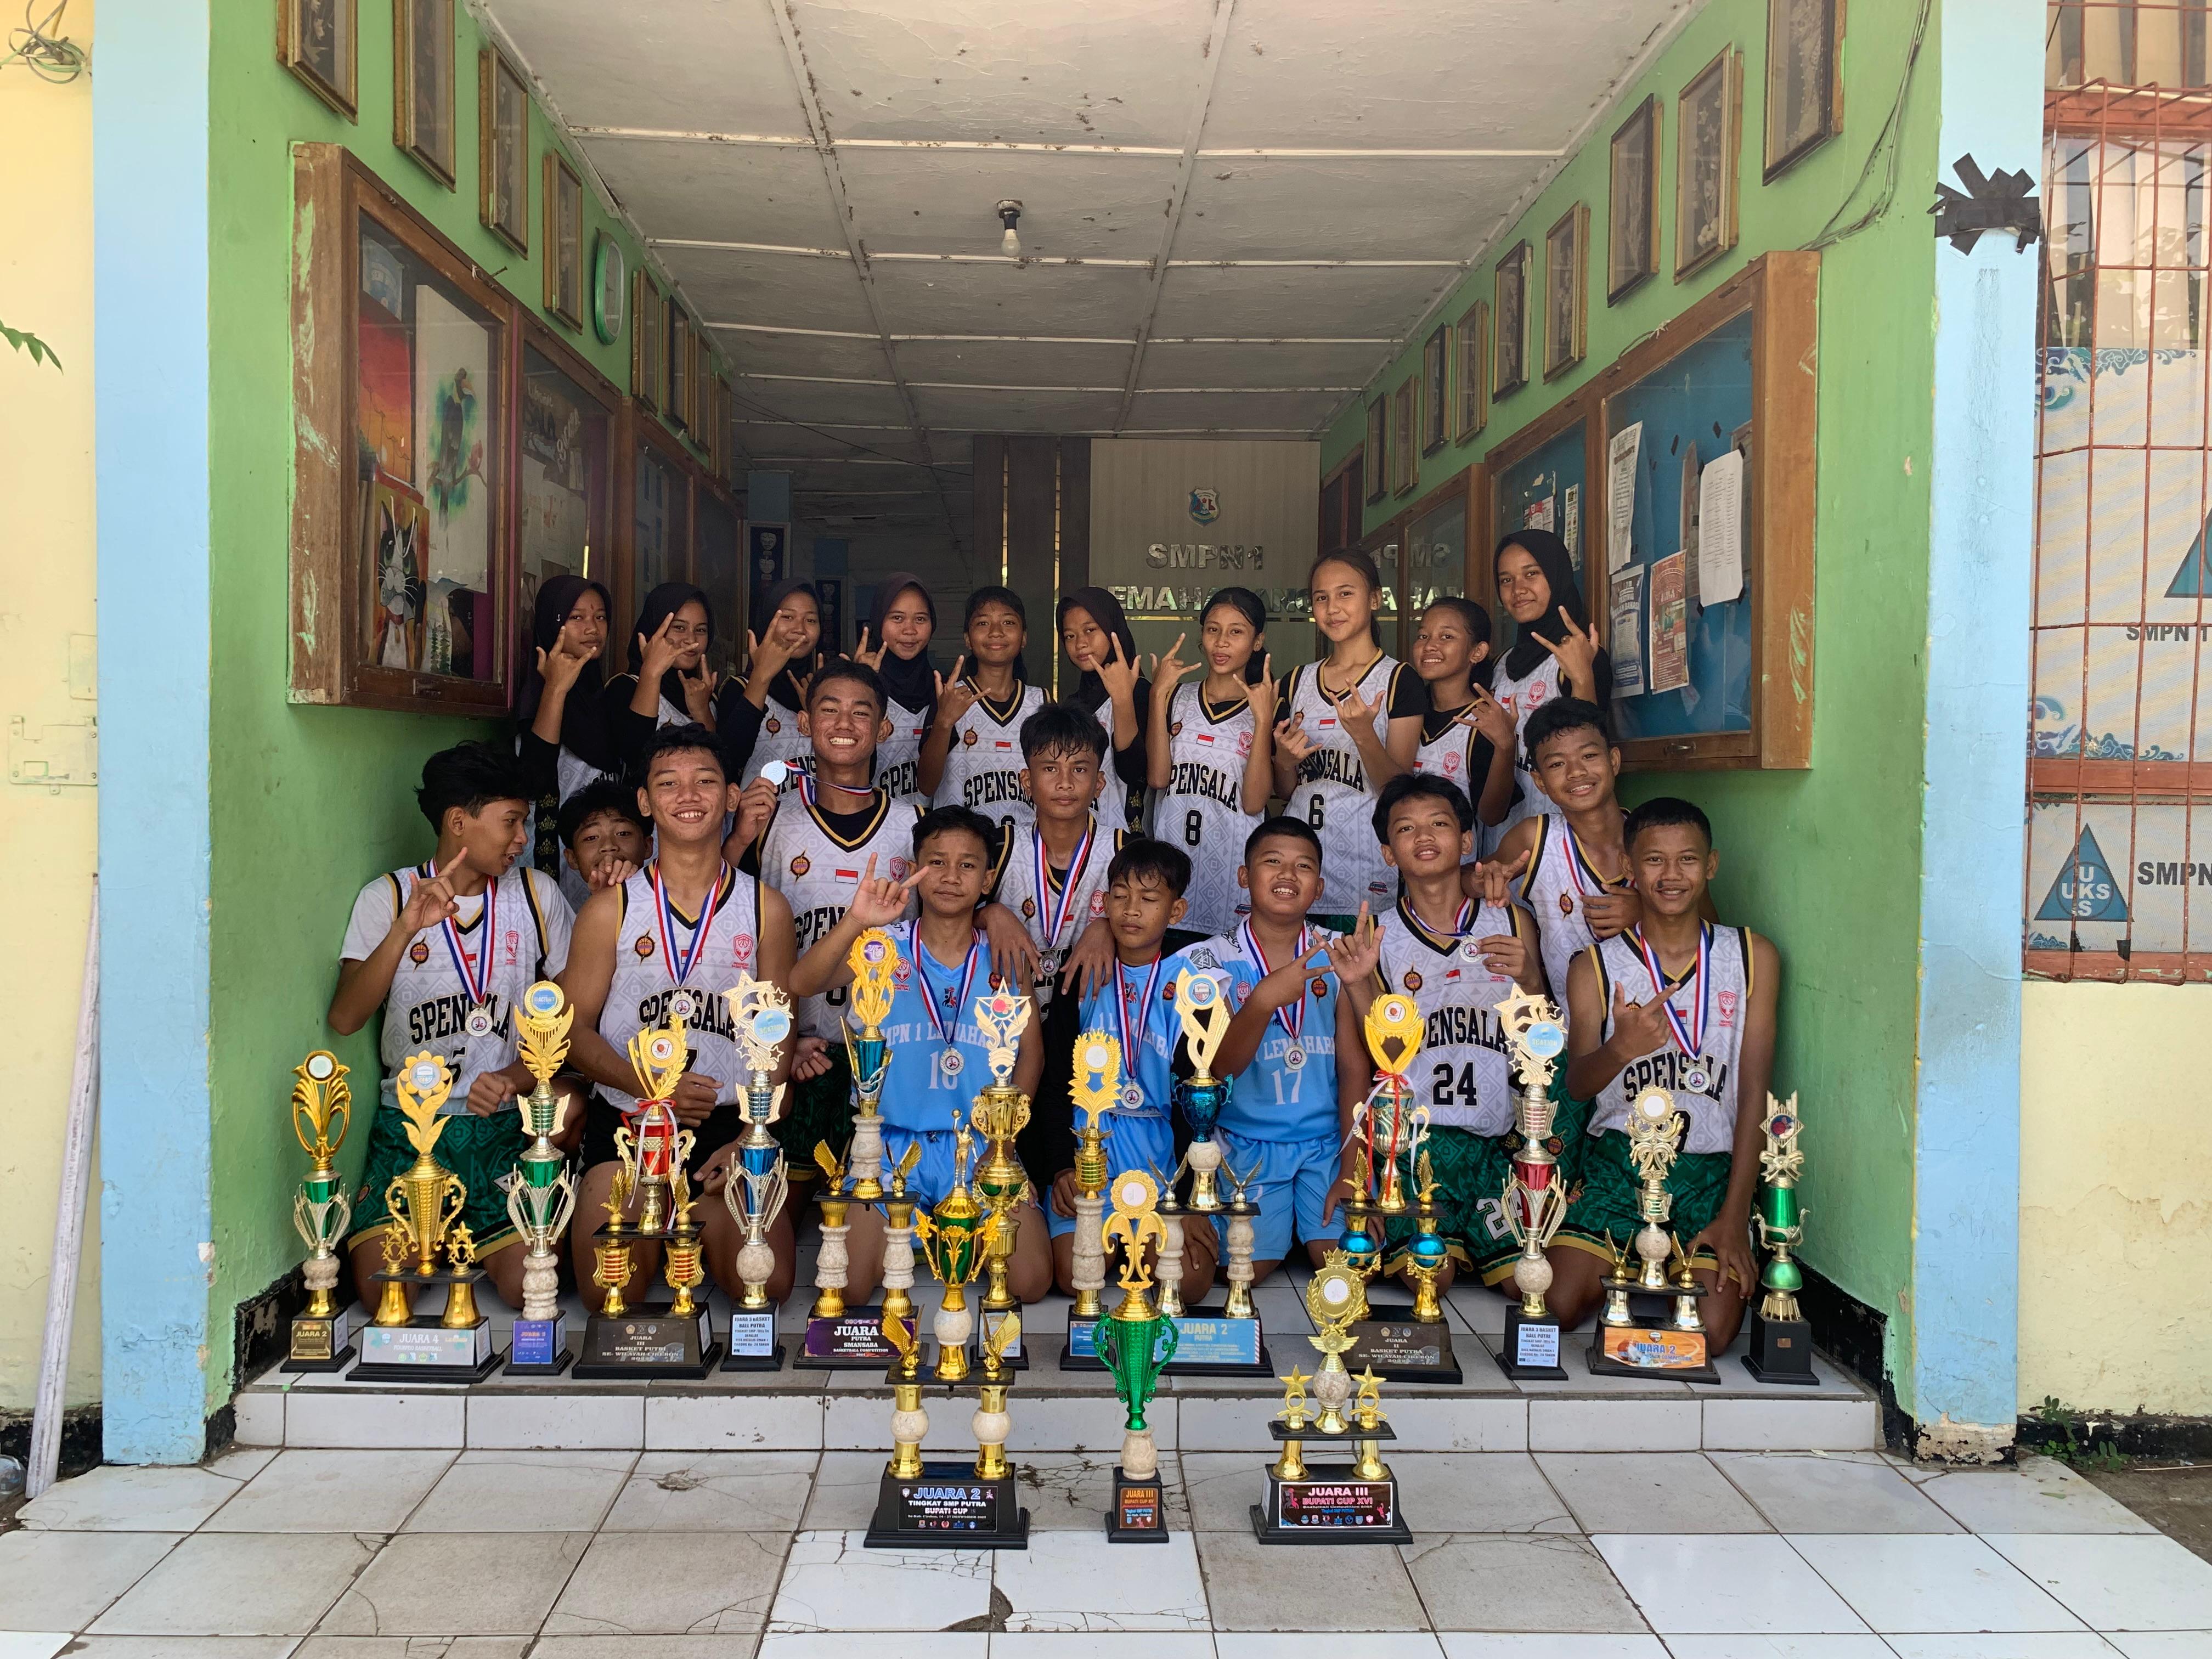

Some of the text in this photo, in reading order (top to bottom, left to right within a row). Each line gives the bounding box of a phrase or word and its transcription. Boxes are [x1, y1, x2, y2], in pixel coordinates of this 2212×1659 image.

[1147, 543, 1263, 570] SMPN 1
[2126, 626, 2189, 641] SMPN
[879, 759, 918, 799] SPEN
[964, 770, 1036, 809] SPENS
[1164, 763, 1238, 813] PENSALA
[1184, 809, 1203, 847] 8
[1308, 794, 1324, 831] 6
[2079, 866, 2094, 882] U
[2062, 883, 2110, 899] UKS
[794, 906, 848, 950] SPEN
[409, 993, 511, 1045] SPENLA
[639, 988, 736, 1045] SPESALA
[1422, 1006, 1508, 1056] ENSALA
[882, 1023, 911, 1047] MPN
[1271, 1068, 1302, 1105] 17
[1432, 1062, 1477, 1106] 24
[1623, 1051, 1728, 1105] SPENSLA
[399, 1334, 430, 1344] JUARA
[432, 1334, 439, 1344] 4
[834, 1326, 879, 1336] JUARA
[1180, 1323, 1228, 1335] JUARA 2
[1669, 1345, 1677, 1355] 2
[913, 1487, 980, 1500] JUARA 2
[1308, 1487, 1368, 1496] JUARA III
[1357, 1497, 1373, 1505] XVI
